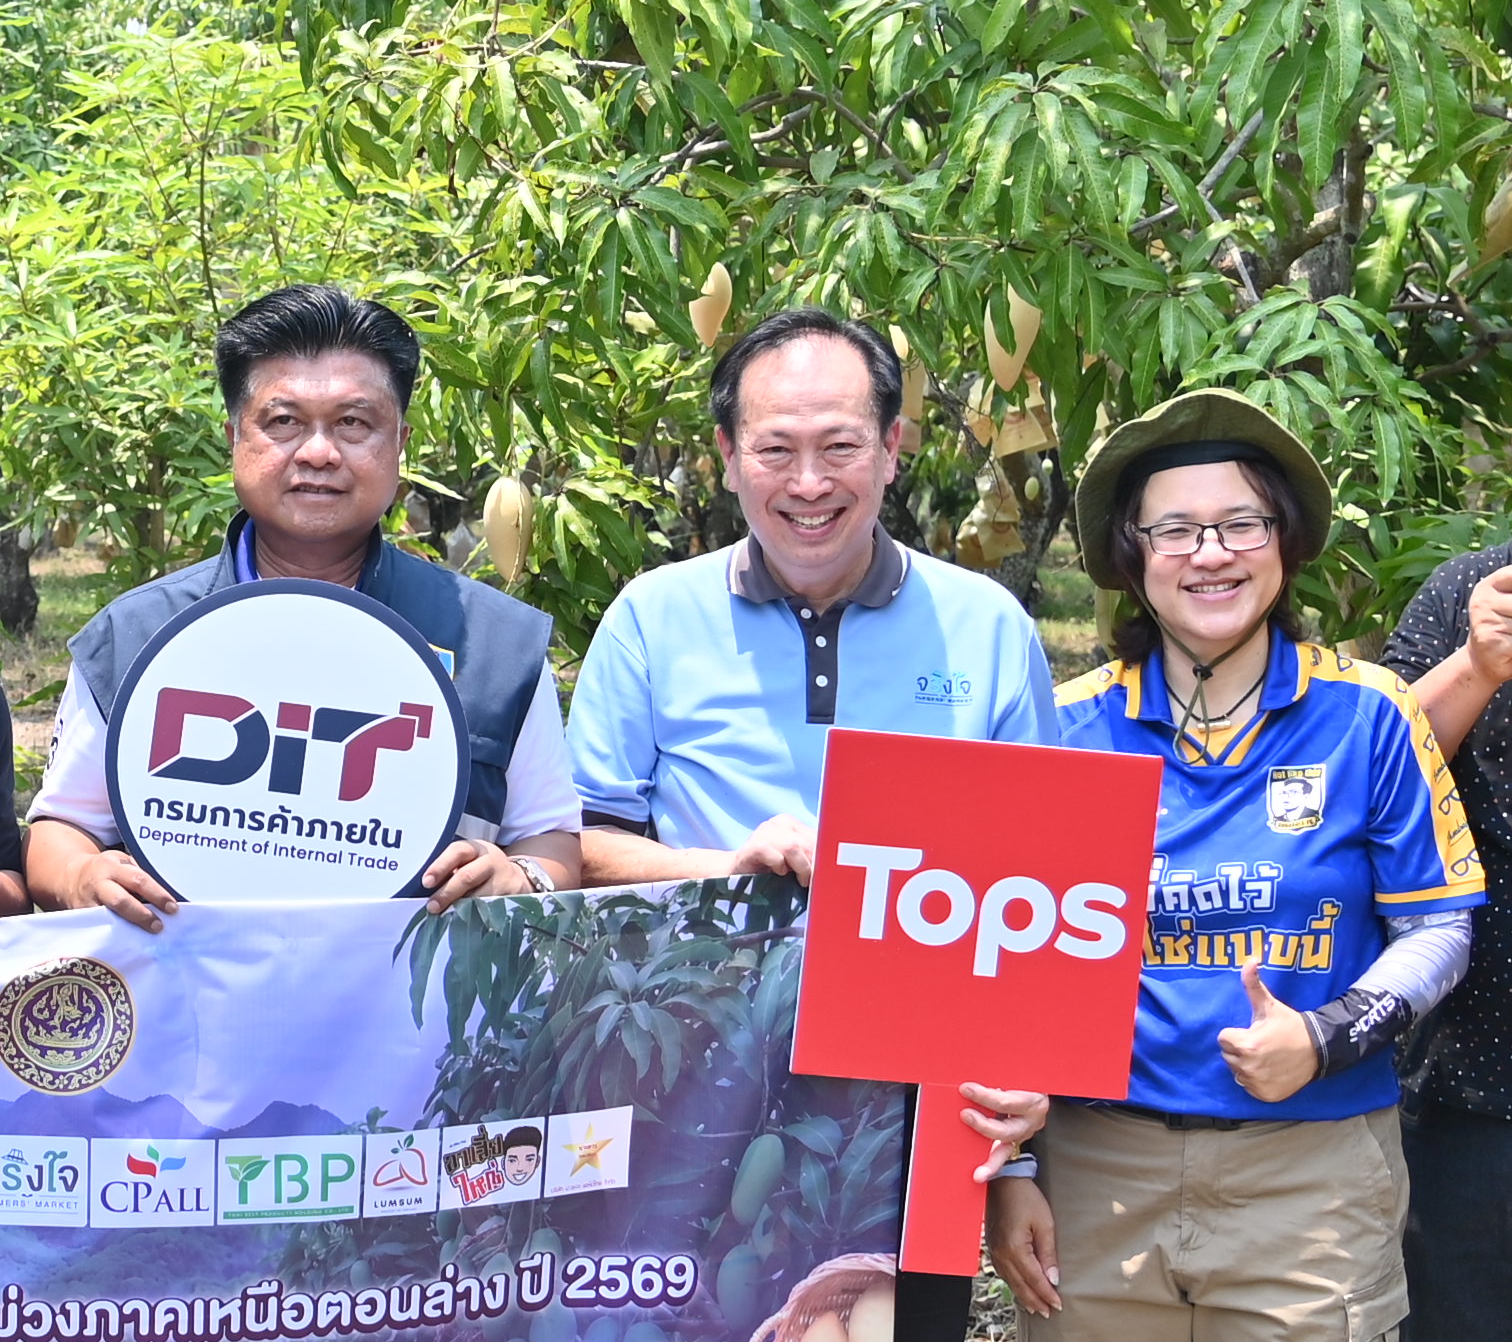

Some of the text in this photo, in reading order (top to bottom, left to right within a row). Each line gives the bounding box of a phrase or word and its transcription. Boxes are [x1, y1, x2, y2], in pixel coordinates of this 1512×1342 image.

[139, 825, 399, 871] Department of Internal Trade
[143, 797, 403, 849] กรมการค้าภายใน
[836, 842, 1127, 977] Tops
[225, 1153, 355, 1205] TBP
[451, 1161, 505, 1205] ใหญ่
[35, 1200, 79, 1210] MARKET
[518, 1253, 554, 1304] ปี
[564, 1255, 695, 1301] 2569
